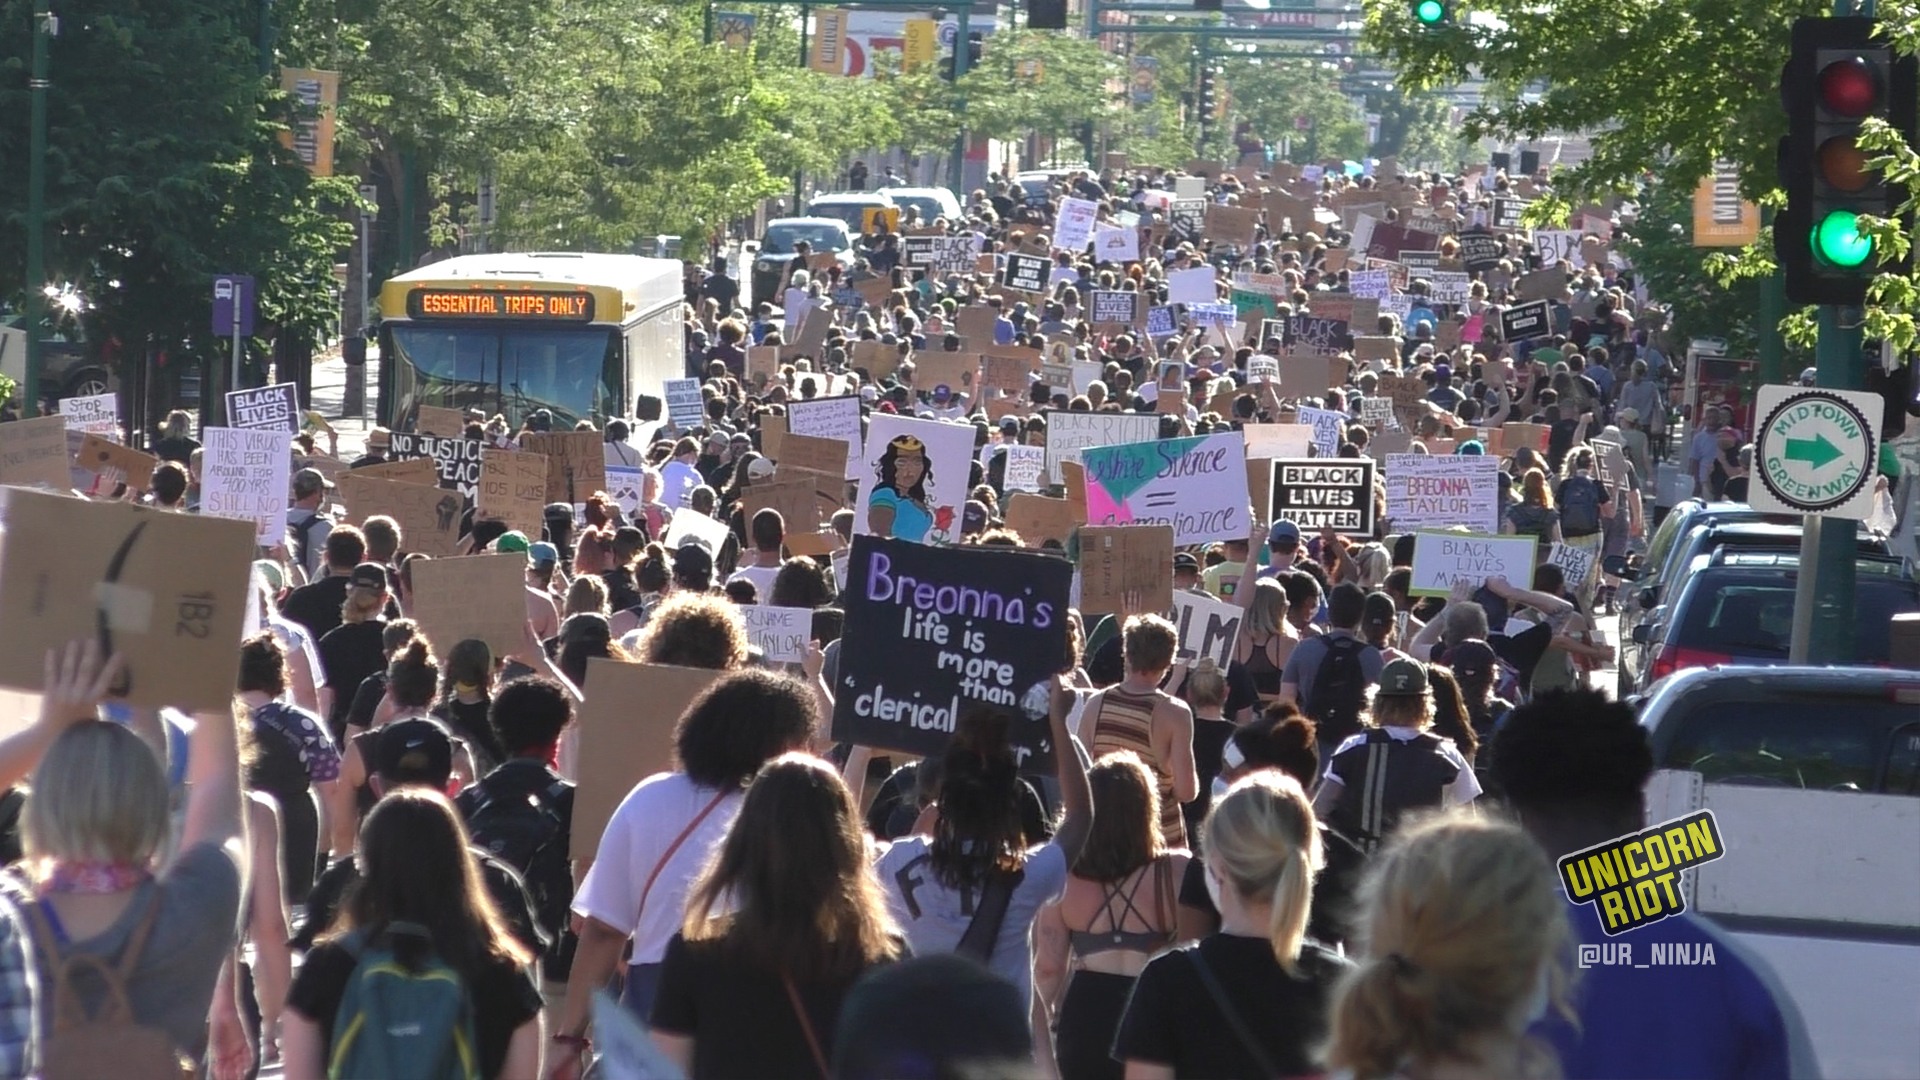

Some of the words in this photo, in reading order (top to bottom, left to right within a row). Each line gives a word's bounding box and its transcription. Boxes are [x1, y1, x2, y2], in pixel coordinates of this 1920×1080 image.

[934, 239, 975, 252] BLACK
[424, 294, 498, 312] ESSENTIAL
[504, 295, 545, 314] TRIPS
[550, 296, 586, 315] ONLY
[1097, 294, 1131, 302] BLACK
[1432, 290, 1471, 303] POLICE
[1097, 302, 1131, 311] LIVES
[1290, 318, 1337, 338] BLACK
[69, 399, 101, 412] Stop
[235, 387, 287, 409] BLACK
[64, 411, 114, 424] pretending
[237, 403, 288, 425] LIVES
[1053, 415, 1098, 431] BLACK
[1302, 411, 1338, 431] BLACK
[1773, 403, 1860, 440] MIDTOWN
[210, 429, 239, 450] THIS
[245, 431, 281, 453] VIRUS
[1051, 435, 1094, 449] QUEER
[1313, 428, 1336, 445] VES
[391, 434, 412, 453] NO
[419, 436, 491, 461] JUSTICE
[1011, 448, 1042, 460] BLACK
[217, 452, 238, 465] HAS
[244, 452, 273, 466] BEEN
[1086, 453, 1146, 483] White
[1156, 442, 1228, 480] Silence
[210, 465, 247, 477] AROUND
[253, 468, 274, 478] FOR
[433, 458, 481, 484] PEAC
[1285, 467, 1360, 484] BLACK
[1767, 456, 1860, 499] GREENWAY
[222, 478, 246, 493] 400
[485, 482, 508, 495] 105
[515, 484, 544, 498] DAYS
[1407, 478, 1472, 497] BREONNA
[208, 491, 250, 513] STILL
[257, 498, 281, 513] NO
[1289, 488, 1354, 506] LIVES
[1408, 498, 1469, 514] TAYLOR
[1442, 540, 1495, 558] BLACK
[1556, 543, 1588, 564] BLACK
[1456, 557, 1506, 572] LIVES
[1554, 554, 1587, 574] LIVES
[868, 551, 1053, 628] Breonna's
[176, 591, 216, 640] 1B2
[760, 611, 794, 627] NAME
[903, 606, 949, 646] life
[963, 620, 986, 655] is
[752, 628, 808, 656] TAYLOR
[937, 652, 1014, 687] more
[958, 675, 1016, 706] than
